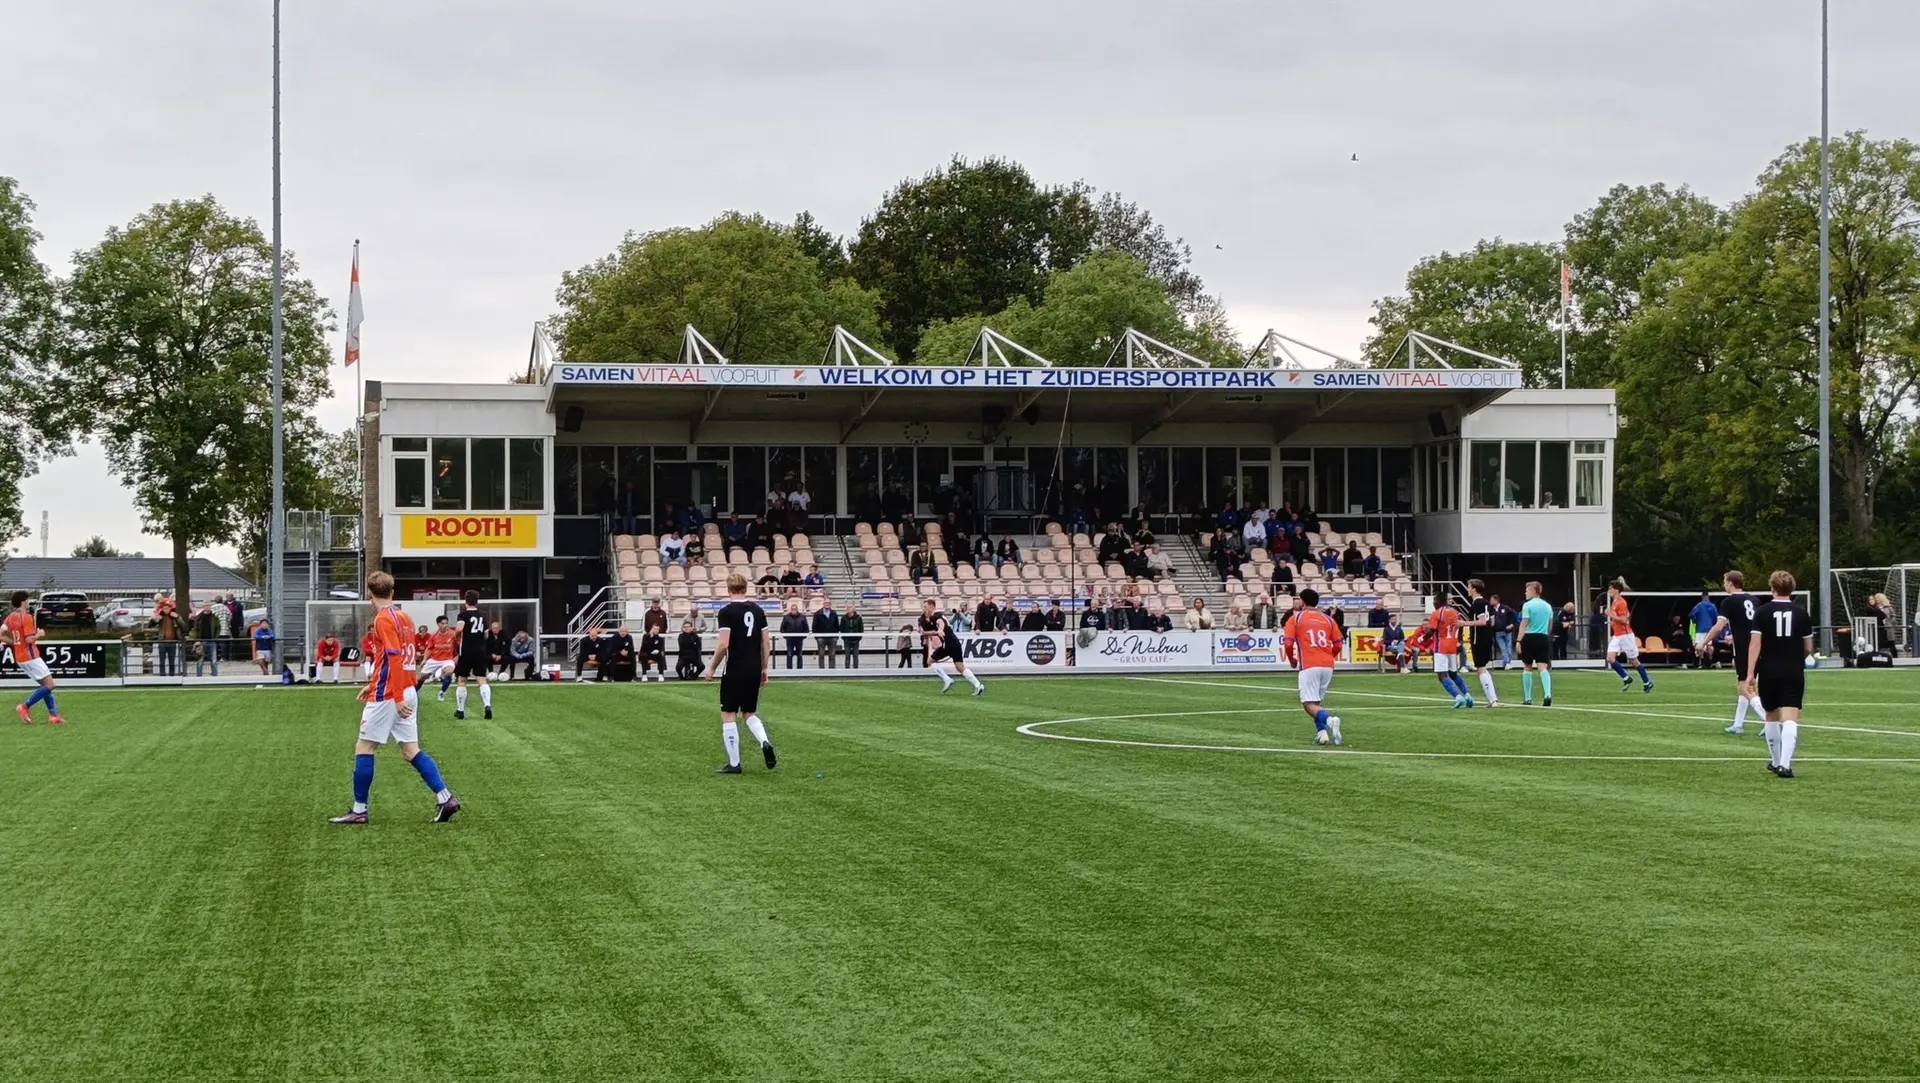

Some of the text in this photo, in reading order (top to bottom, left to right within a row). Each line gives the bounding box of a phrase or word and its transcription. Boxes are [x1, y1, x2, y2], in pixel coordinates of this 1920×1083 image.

[561, 367, 780, 383] SAMEN VITAAL VOORUIT
[819, 368, 1276, 387] WELKOM OP HET ZUIDERSPORTPARK
[1313, 372, 1515, 387] SAMEN VITAAL VOORUIT
[425, 517, 512, 537] ROOTH
[1743, 599, 1755, 621] 8
[469, 616, 484, 634] 24
[743, 611, 755, 637] 9
[1773, 610, 1793, 637] 11
[1100, 635, 1188, 655] De Walrus
[1258, 637, 1272, 648] BV
[1306, 628, 1328, 648] 18
[1119, 653, 1169, 664] GRAND CAFÉ
